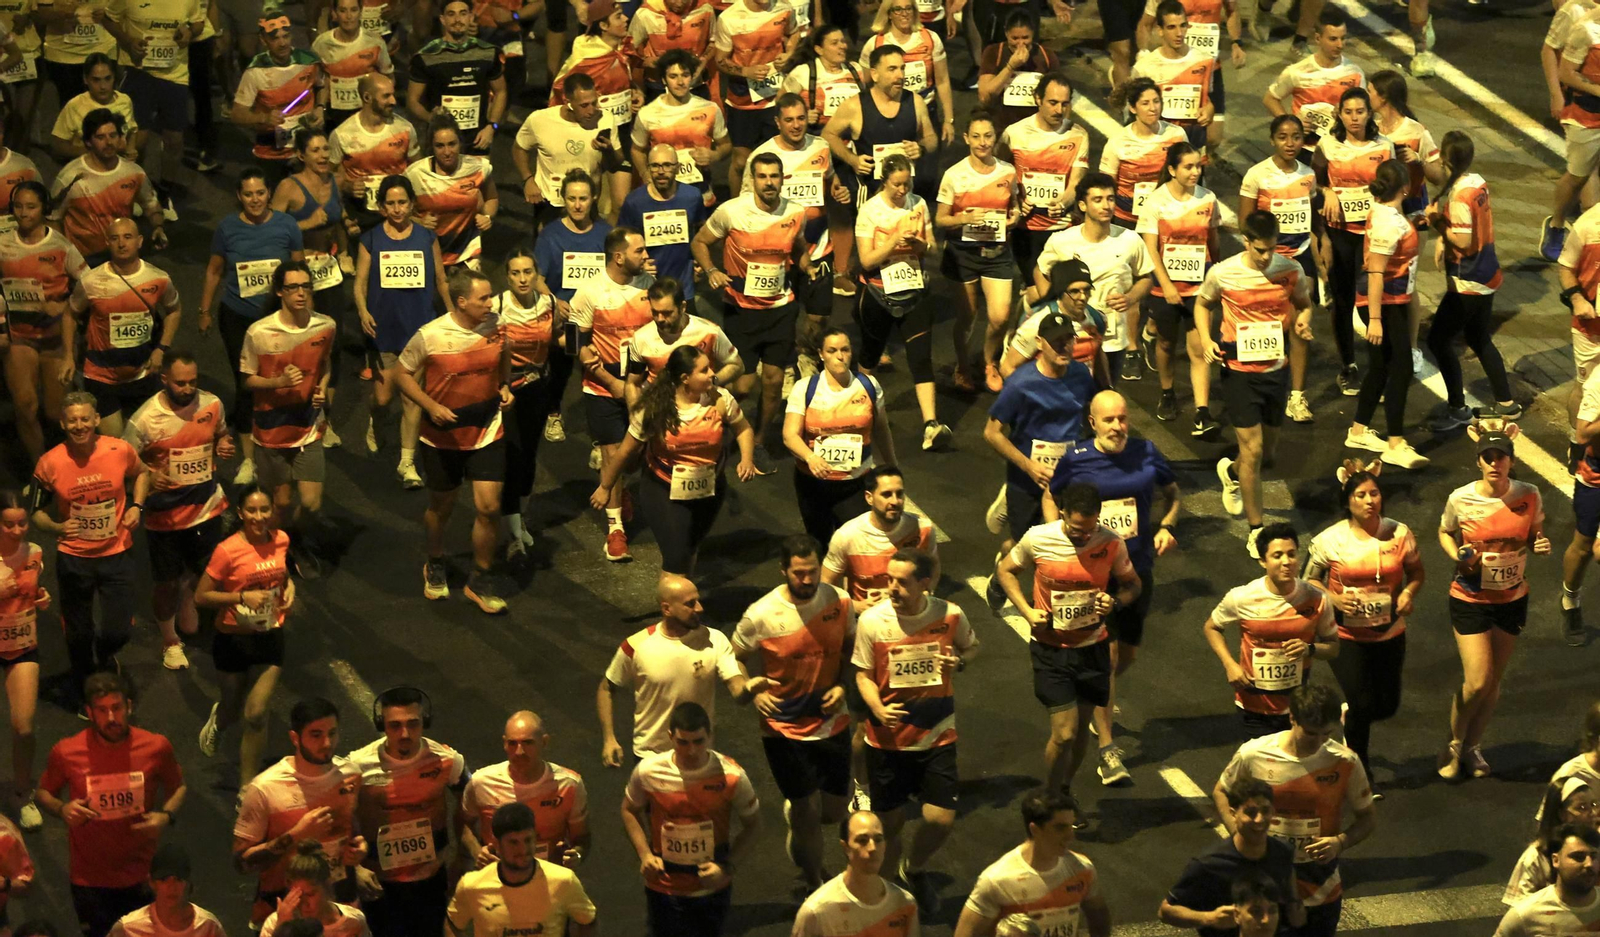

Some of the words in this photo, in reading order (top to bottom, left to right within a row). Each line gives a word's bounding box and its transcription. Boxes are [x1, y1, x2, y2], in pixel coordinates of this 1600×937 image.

[74, 25, 96, 35] 600
[1184, 36, 1214, 47] 17686
[150, 47, 174, 58] 1609
[1167, 98, 1196, 109] 17781
[786, 185, 817, 197] 14270
[1026, 186, 1058, 198] 21016
[649, 223, 683, 236] 22405
[1167, 259, 1200, 271] 22980
[385, 266, 419, 278] 22399
[754, 276, 780, 288] 7958
[115, 325, 149, 338] 14659
[1243, 337, 1278, 350] 16199
[819, 448, 856, 461] 21274
[175, 460, 208, 474] 19555
[77, 473, 102, 486] XXXV
[680, 479, 708, 491] 1030
[255, 560, 276, 571] XXXV
[1491, 565, 1519, 580] 7192
[895, 660, 934, 676] 24656
[1258, 664, 1297, 679] 11322
[99, 792, 134, 809] 5198
[383, 837, 427, 857] 21696
[667, 839, 707, 854] 20151
